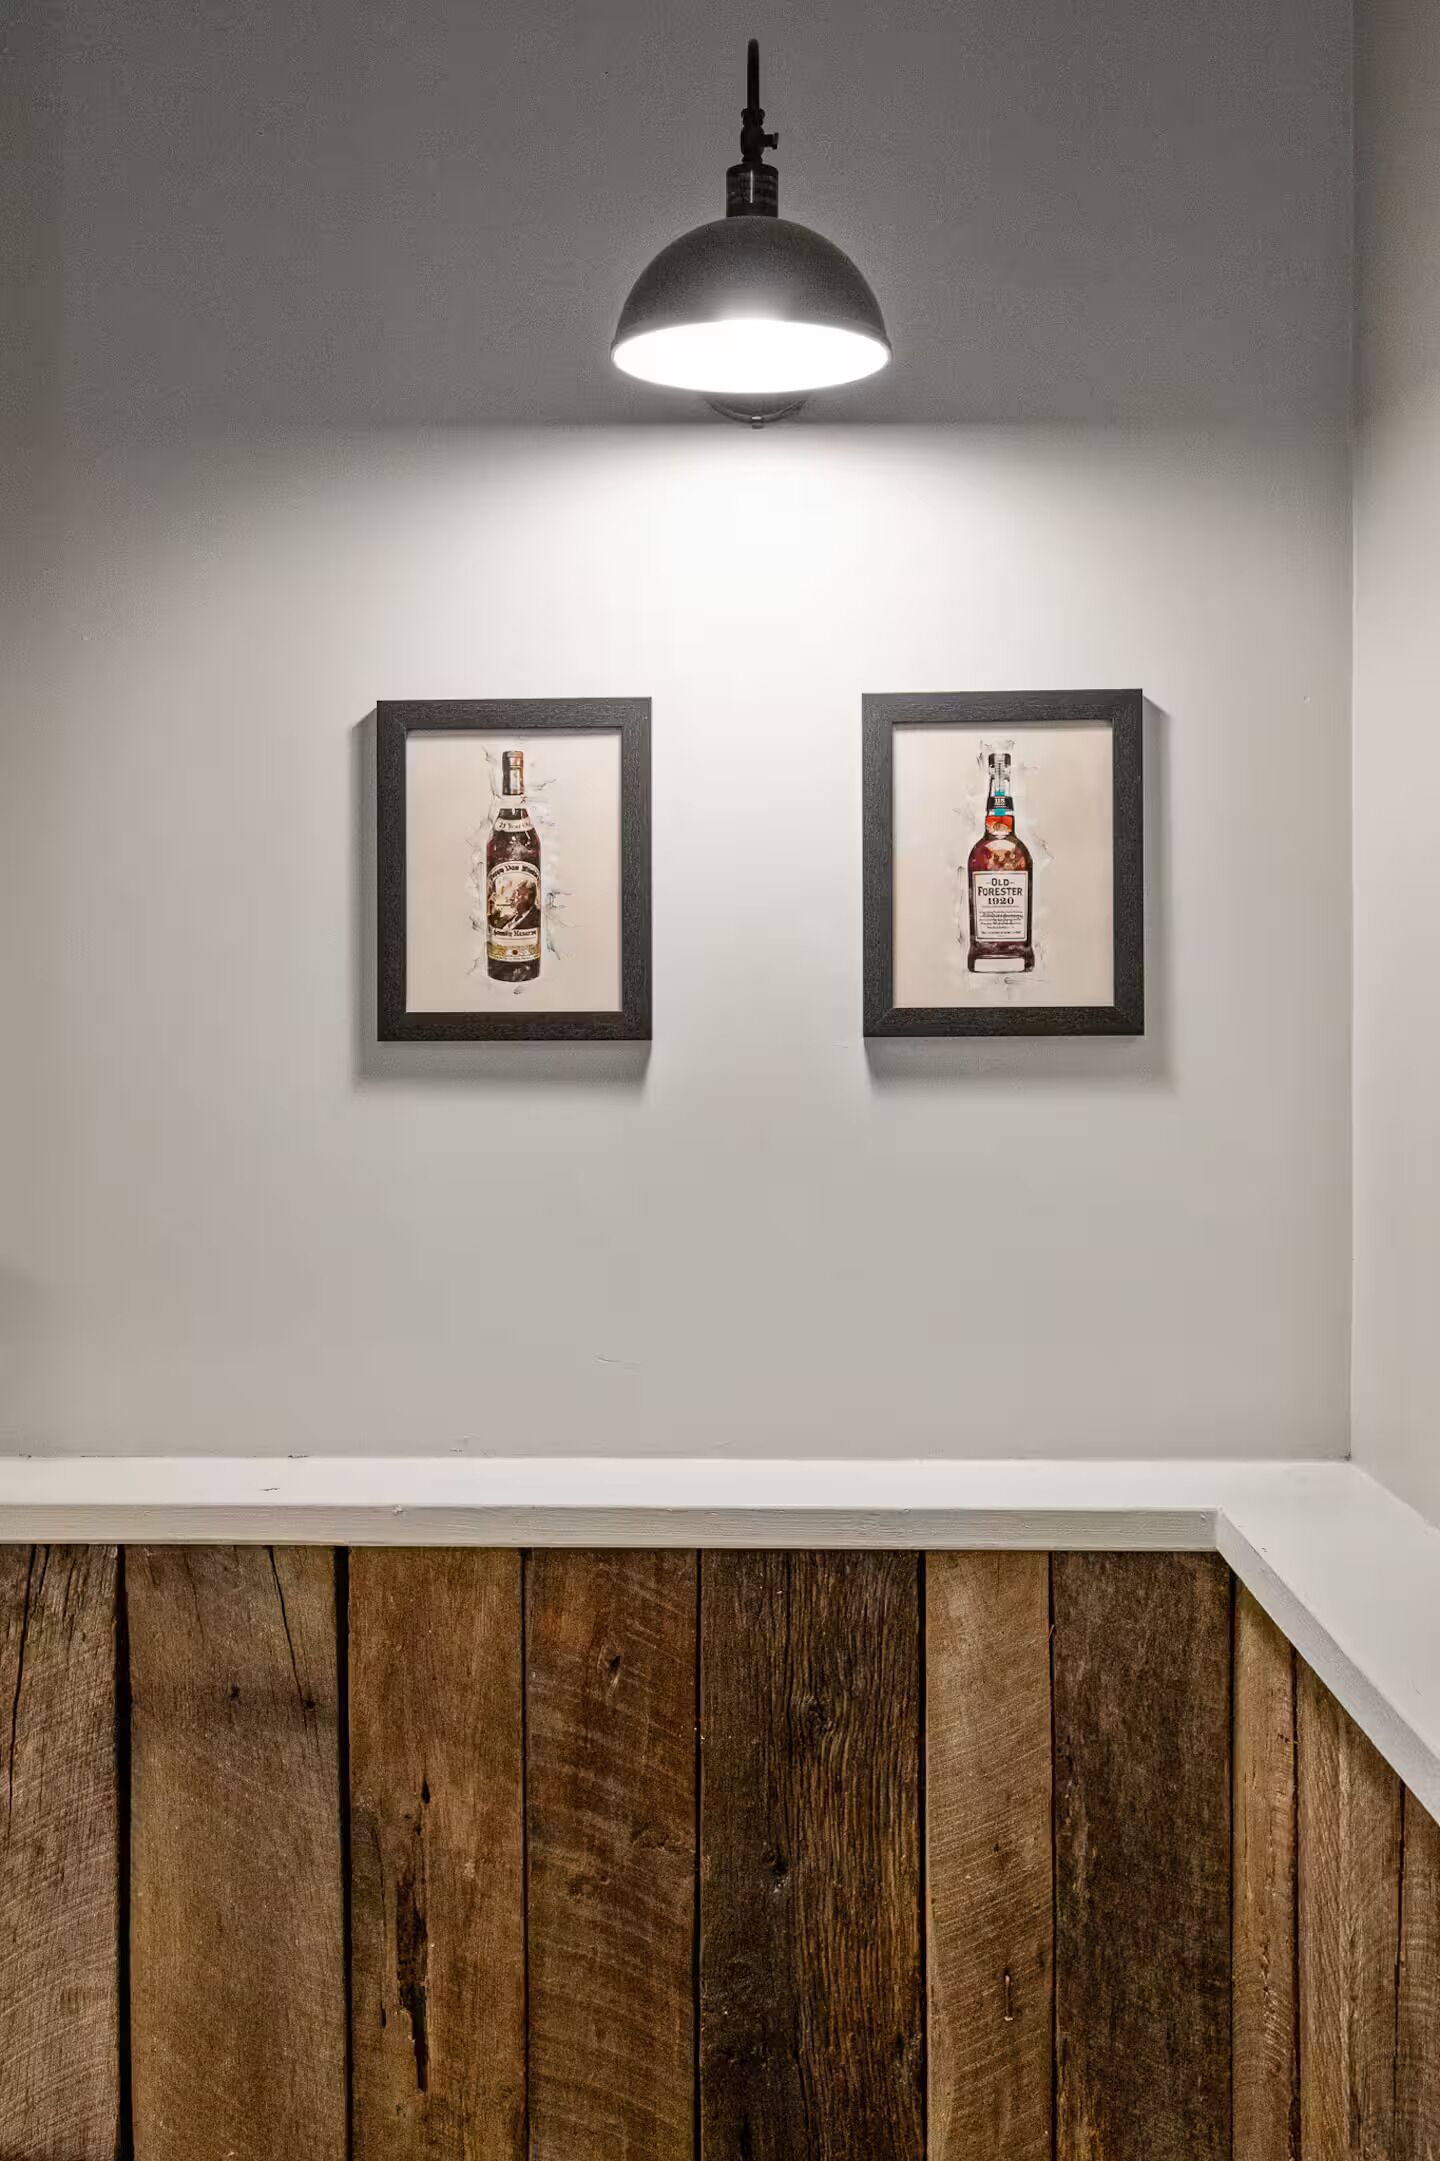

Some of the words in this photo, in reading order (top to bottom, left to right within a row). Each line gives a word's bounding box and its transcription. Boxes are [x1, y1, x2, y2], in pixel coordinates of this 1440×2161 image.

[991, 877, 1010, 887] OLD
[977, 886, 1023, 897] FORESTER
[988, 896, 1015, 905] 1920
